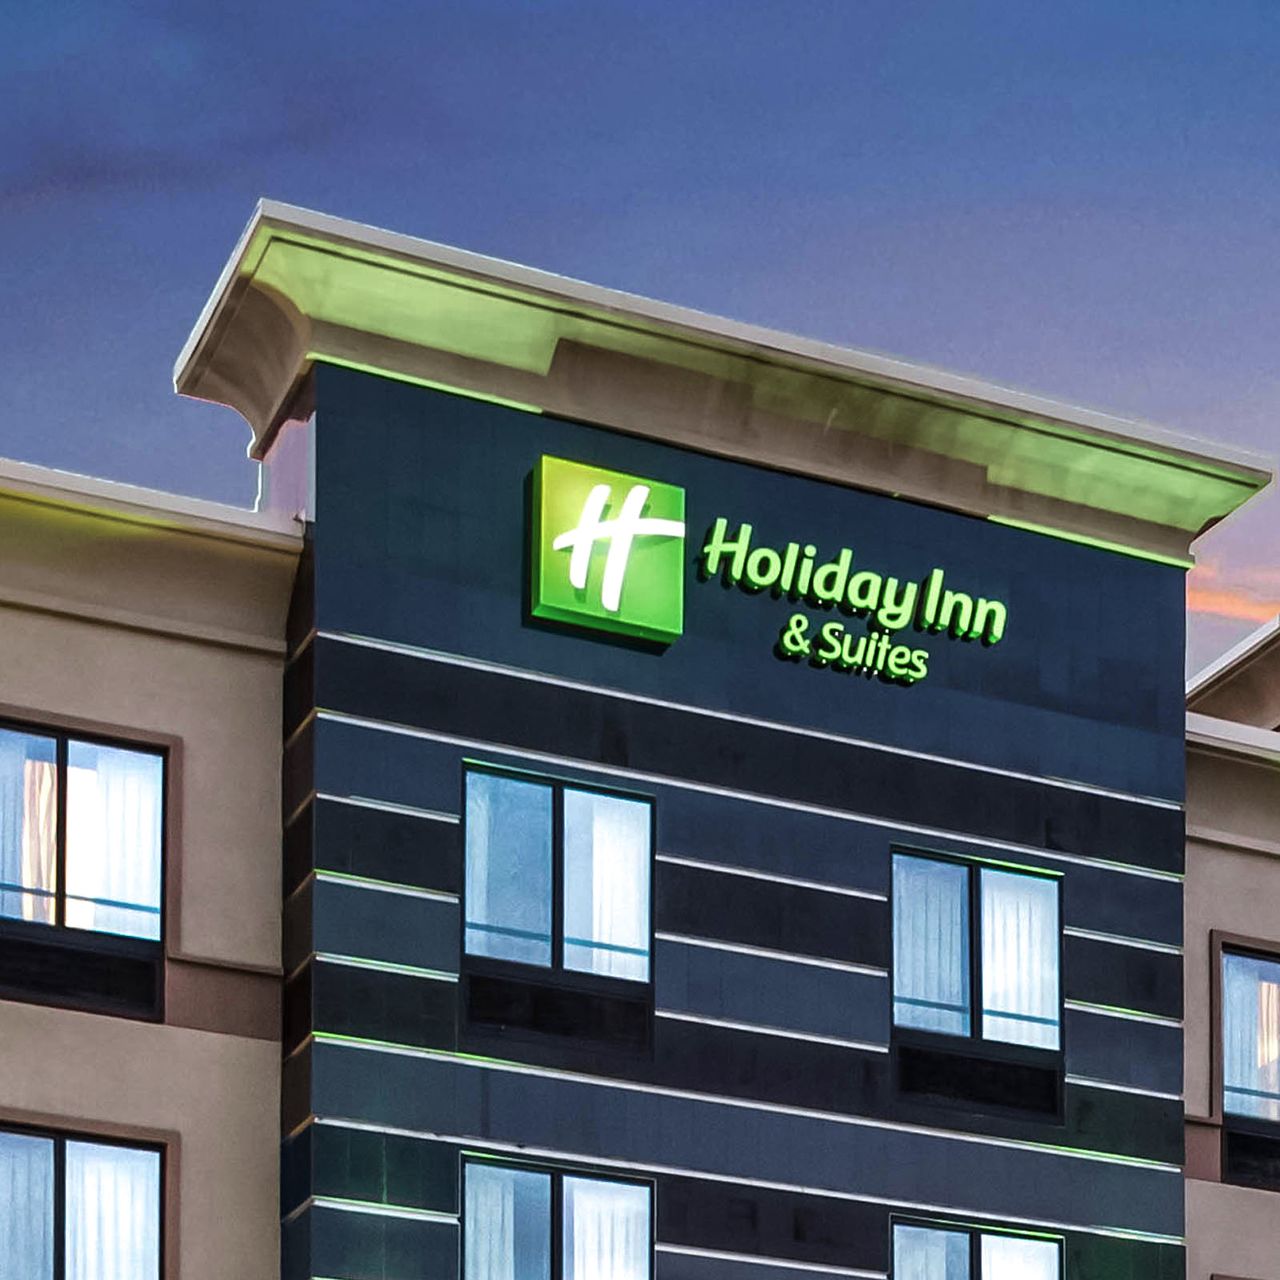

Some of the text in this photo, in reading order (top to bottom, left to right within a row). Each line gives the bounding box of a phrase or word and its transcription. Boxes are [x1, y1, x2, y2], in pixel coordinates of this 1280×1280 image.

[703, 517, 1008, 643] Holiday Inn
[782, 614, 930, 681] & Suites
